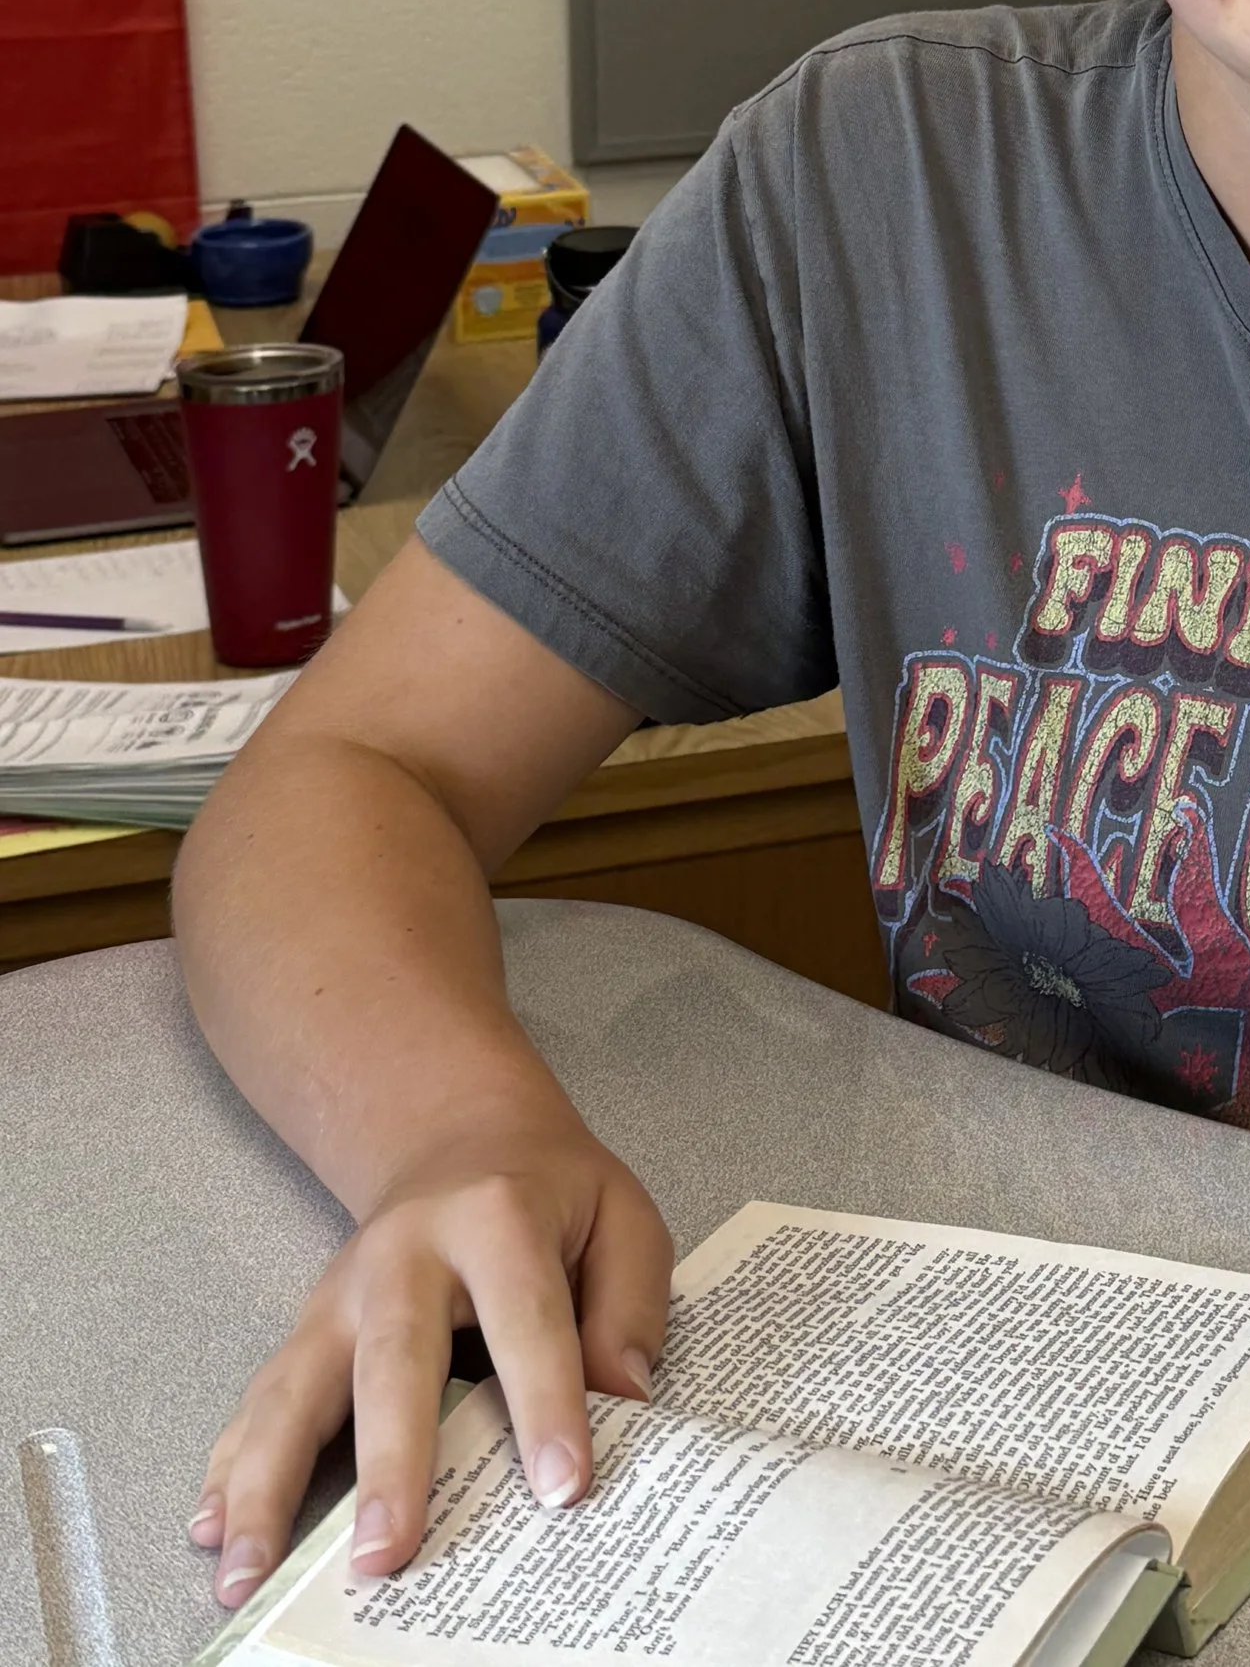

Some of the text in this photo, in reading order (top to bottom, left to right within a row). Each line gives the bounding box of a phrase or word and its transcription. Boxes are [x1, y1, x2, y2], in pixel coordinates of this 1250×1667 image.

[876, 659, 1236, 929] PEACE
[1107, 1477, 1122, 1492] all
[1145, 1412, 1168, 1433] have
[1161, 1445, 1180, 1464] seat
[1211, 1382, 1226, 1397] old
[353, 1436, 508, 1623] she was me. She liked me.
[390, 1469, 513, 1618] Boy, did get in that house
[445, 1580, 463, 1598] me
[458, 1554, 482, 1577] take
[479, 1529, 502, 1552] your
[500, 1503, 526, 1527] coat,
[542, 1575, 562, 1595] you
[557, 1546, 588, 1573] been,
[581, 1521, 606, 1543] Mrs.
[648, 1436, 669, 1455] said
[549, 1620, 577, 1647] door.
[595, 1560, 623, 1584] have
[619, 1538, 638, 1558] you
[659, 1475, 682, 1498] The
[679, 1457, 700, 1476] way
[563, 1580, 590, 1605] been
[585, 1559, 607, 1578] just
[602, 1534, 628, 1556] fine,
[656, 1463, 678, 1482] She
[675, 1434, 703, 1461] closed
[646, 1562, 669, 1586] said.
[694, 1497, 716, 1515] Mr.
[663, 1594, 691, 1622] know
[689, 1565, 713, 1591] what
[742, 1507, 757, 1518] in
[751, 1490, 771, 1505] his
[674, 1545, 714, 1585] Holden,
[727, 1474, 770, 1515] behaving
[1142, 1478, 1177, 1521] the bed.
[368, 1586, 407, 1627] she did.
[396, 1609, 424, 1632] Mrs.
[469, 1523, 491, 1544] said.
[426, 1513, 533, 1637] hear me ask her how Mr.
[466, 1609, 490, 1629] She
[486, 1579, 514, 1607] hung
[509, 1562, 525, 1577] up
[520, 1545, 540, 1562] my
[535, 1518, 557, 1545] coat
[472, 1599, 512, 1641] brushed
[510, 1578, 529, 1596] my
[523, 1555, 546, 1575] hair
[542, 1528, 570, 1552] back
[566, 1498, 589, 1525] with
[517, 1608, 555, 1645] louder,
[551, 1592, 565, 1605] so
[581, 1540, 606, 1562] hear
[604, 1518, 623, 1537] me.
[563, 1619, 592, 1648] knew
[590, 1591, 613, 1617] right
[610, 1564, 637, 1590] away
[632, 1545, 649, 1563] old
[680, 1469, 702, 1493] told
[787, 1629, 819, 1663] THEY
[814, 1592, 847, 1627] EACH
[841, 1570, 863, 1590] had
[858, 1546, 882, 1569] their
[444, 1613, 471, 1639] deaf.
[582, 1628, 603, 1650] out.
[613, 1615, 644, 1652] grippe
